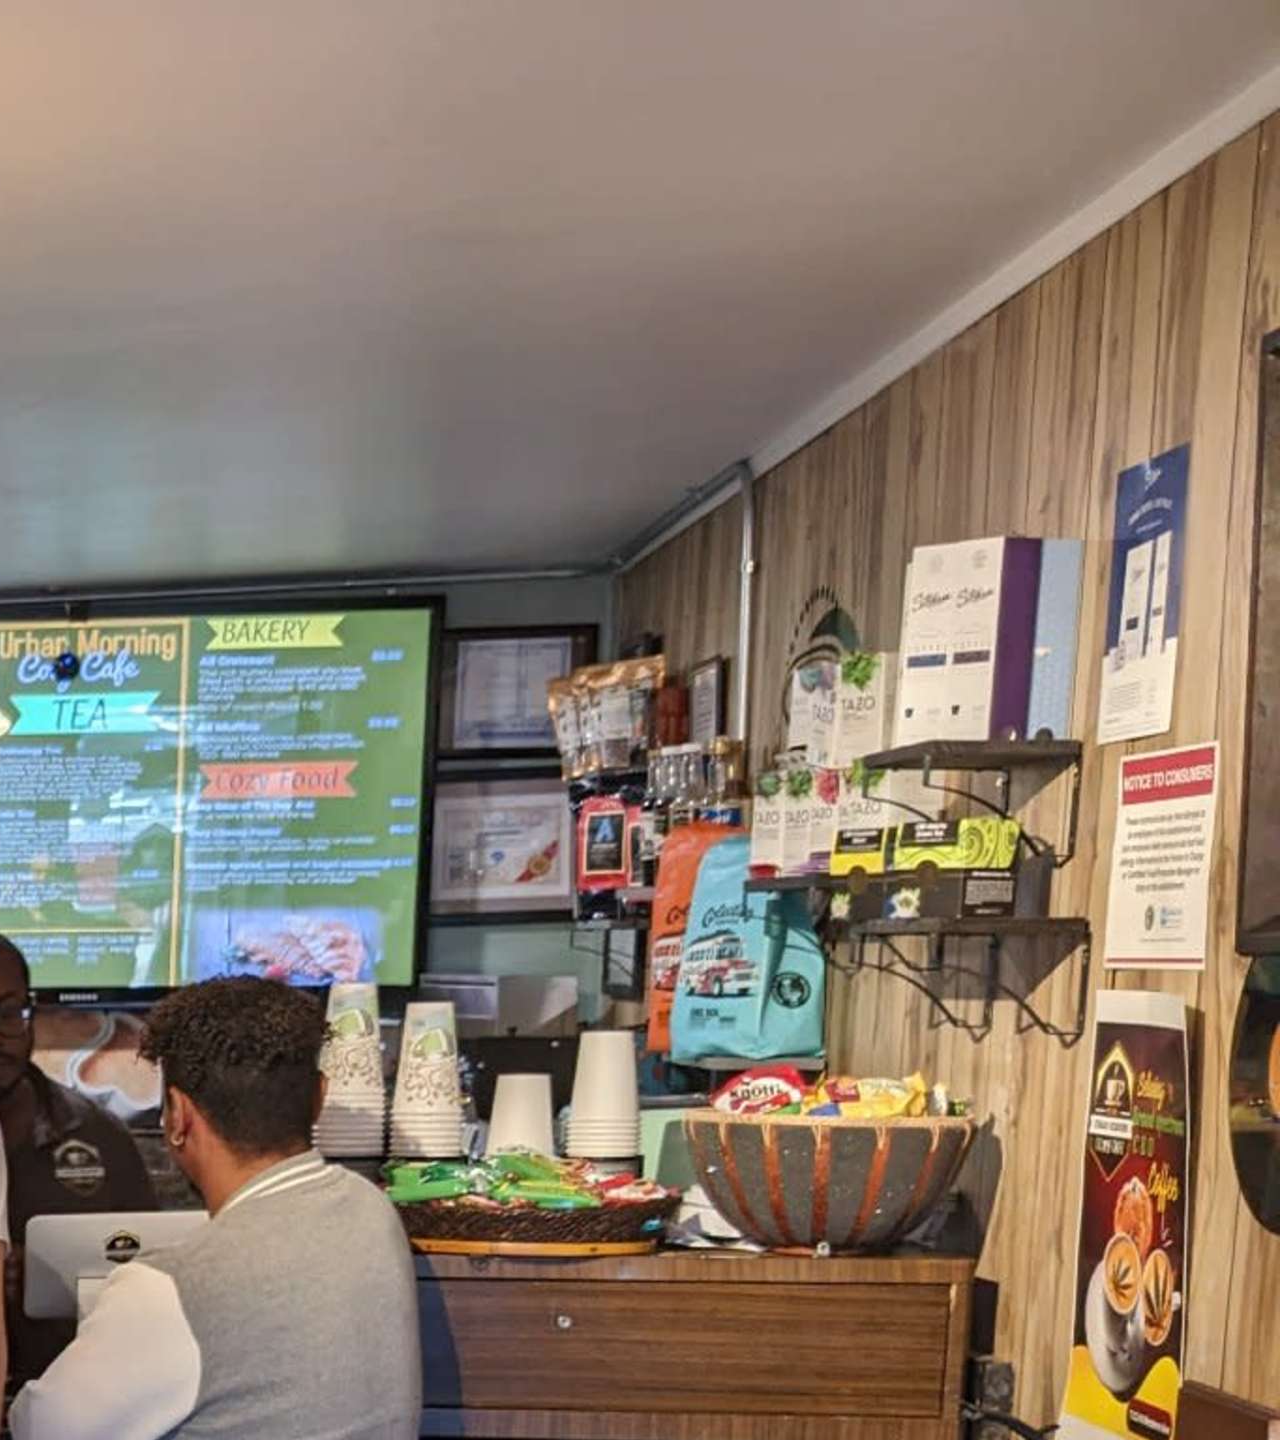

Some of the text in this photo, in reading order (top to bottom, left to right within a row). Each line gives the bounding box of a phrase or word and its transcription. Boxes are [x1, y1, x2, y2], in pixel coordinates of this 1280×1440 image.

[77, 628, 177, 662] Morning
[221, 619, 311, 643] BAKERY
[17, 651, 140, 693] Co Cafe
[51, 697, 109, 731] TEA
[842, 695, 876, 712] TAZO
[279, 764, 340, 792] Food
[1153, 770, 1165, 788] TO
